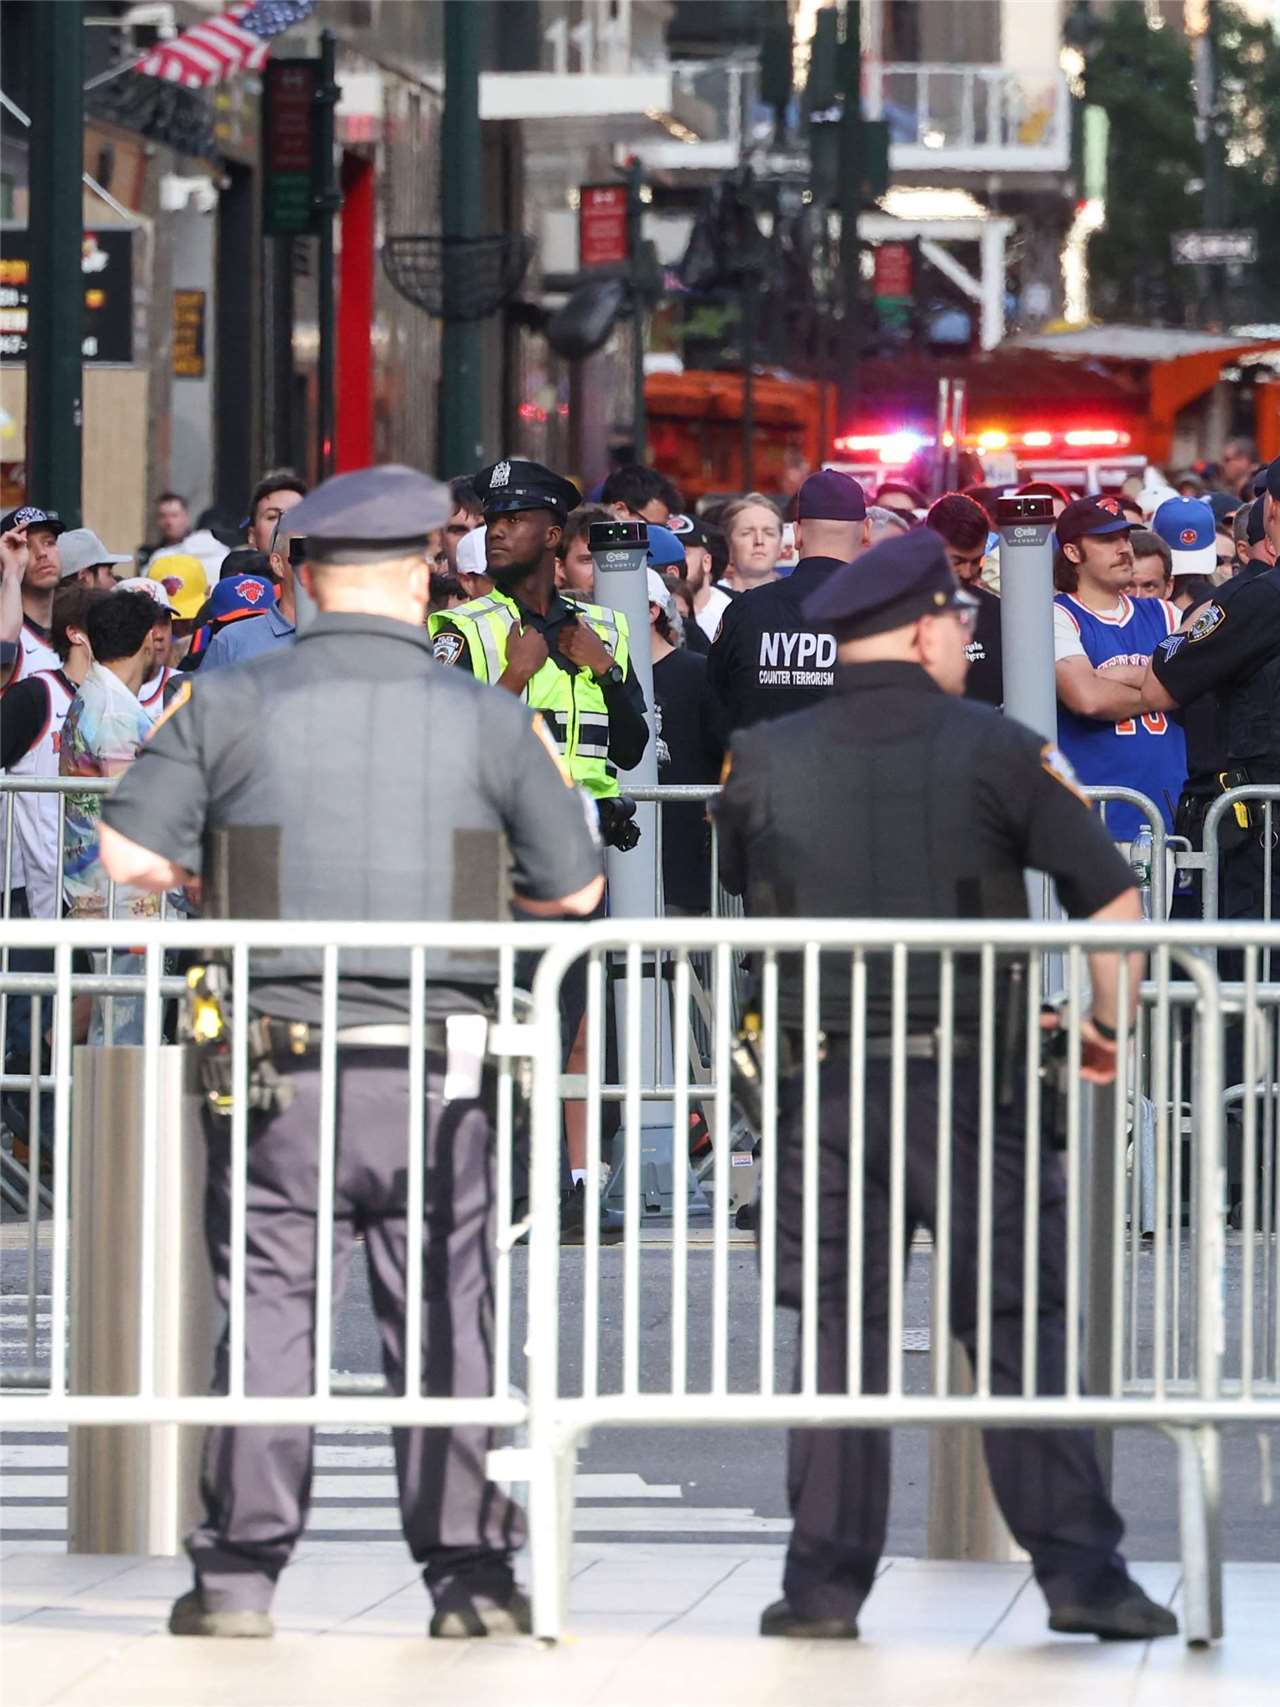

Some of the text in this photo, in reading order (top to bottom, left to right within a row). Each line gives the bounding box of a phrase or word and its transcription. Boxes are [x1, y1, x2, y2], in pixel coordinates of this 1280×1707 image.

[760, 632, 837, 668] NYPD
[759, 670, 834, 686] COUNTER TERRORISM
